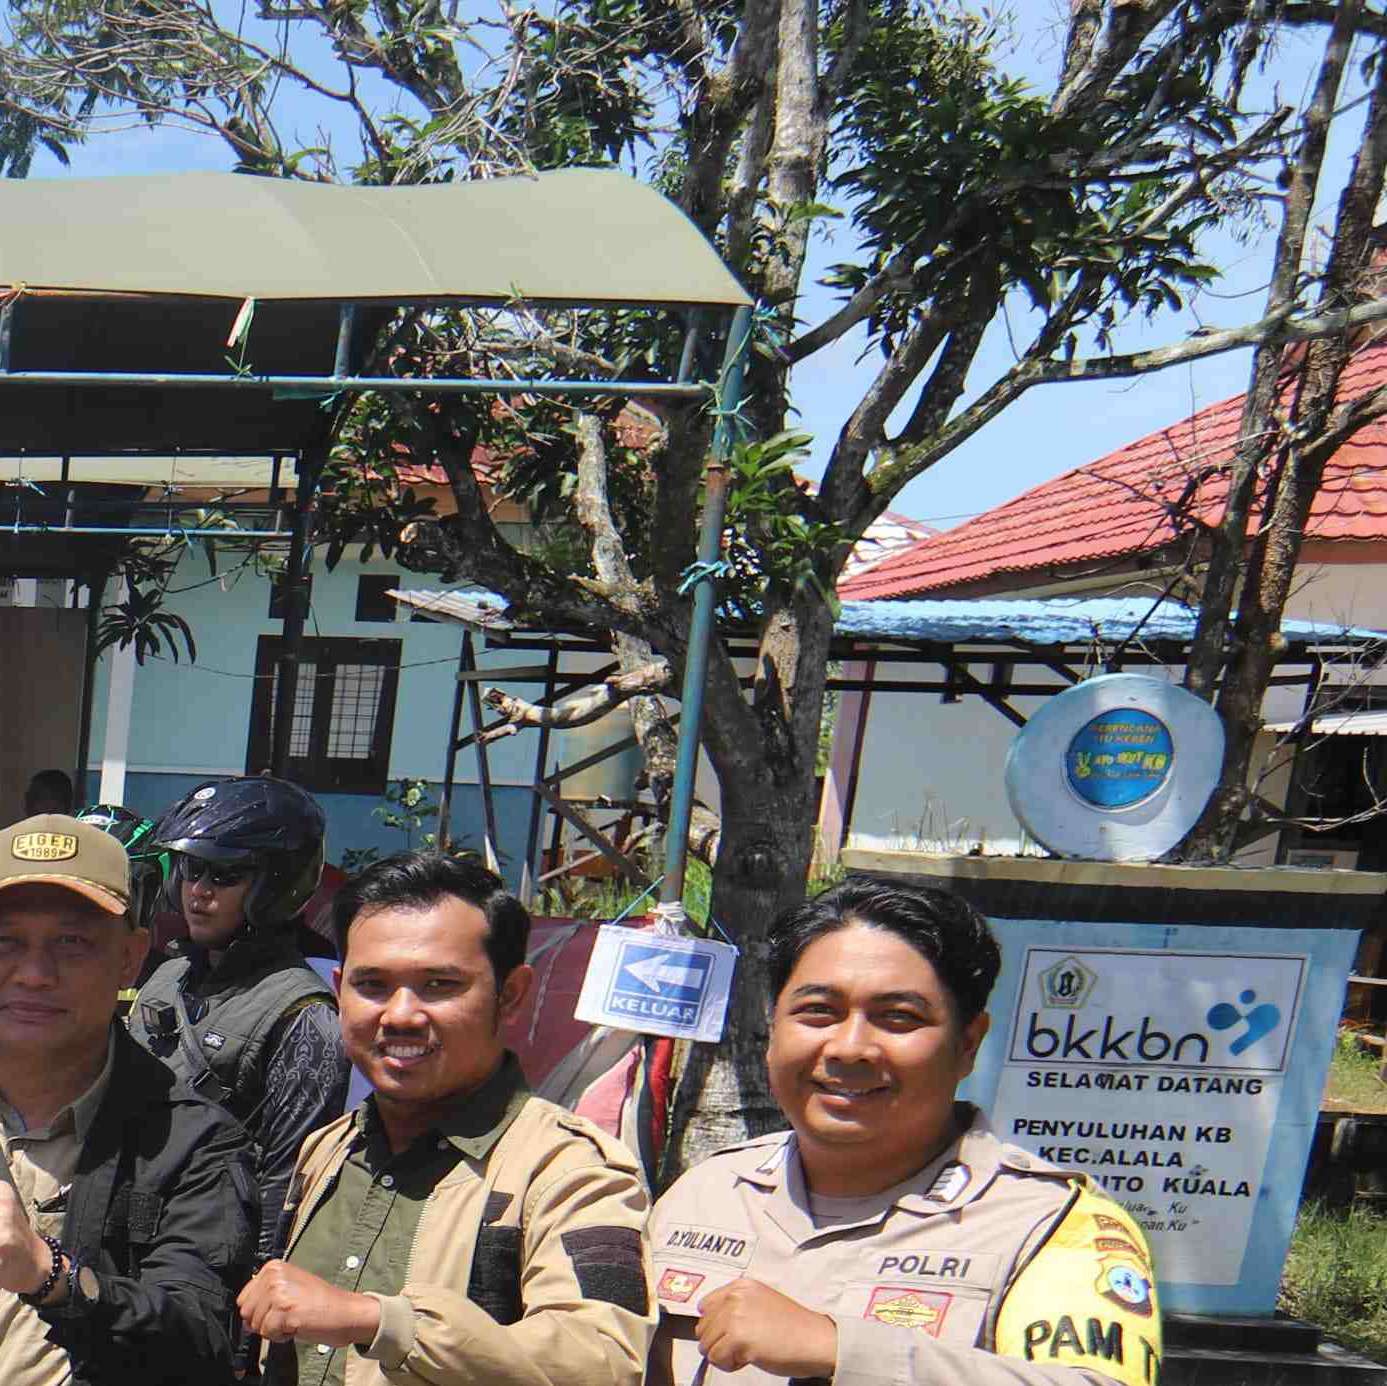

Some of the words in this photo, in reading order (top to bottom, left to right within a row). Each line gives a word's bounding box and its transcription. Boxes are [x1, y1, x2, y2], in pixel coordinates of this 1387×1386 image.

[16, 834, 73, 850] EIGER
[27, 847, 58, 858] 1989
[611, 995, 697, 1021] KELUAR
[1027, 1012, 1209, 1063] bkkbn
[1157, 1076, 1264, 1096] DATANG
[1013, 1118, 1187, 1142] PENYULUHAN
[1195, 1126, 1232, 1143] KB
[1163, 1177, 1251, 1197] KUALA
[877, 1255, 973, 1279] POLRI
[1024, 1314, 1124, 1366] PAM
